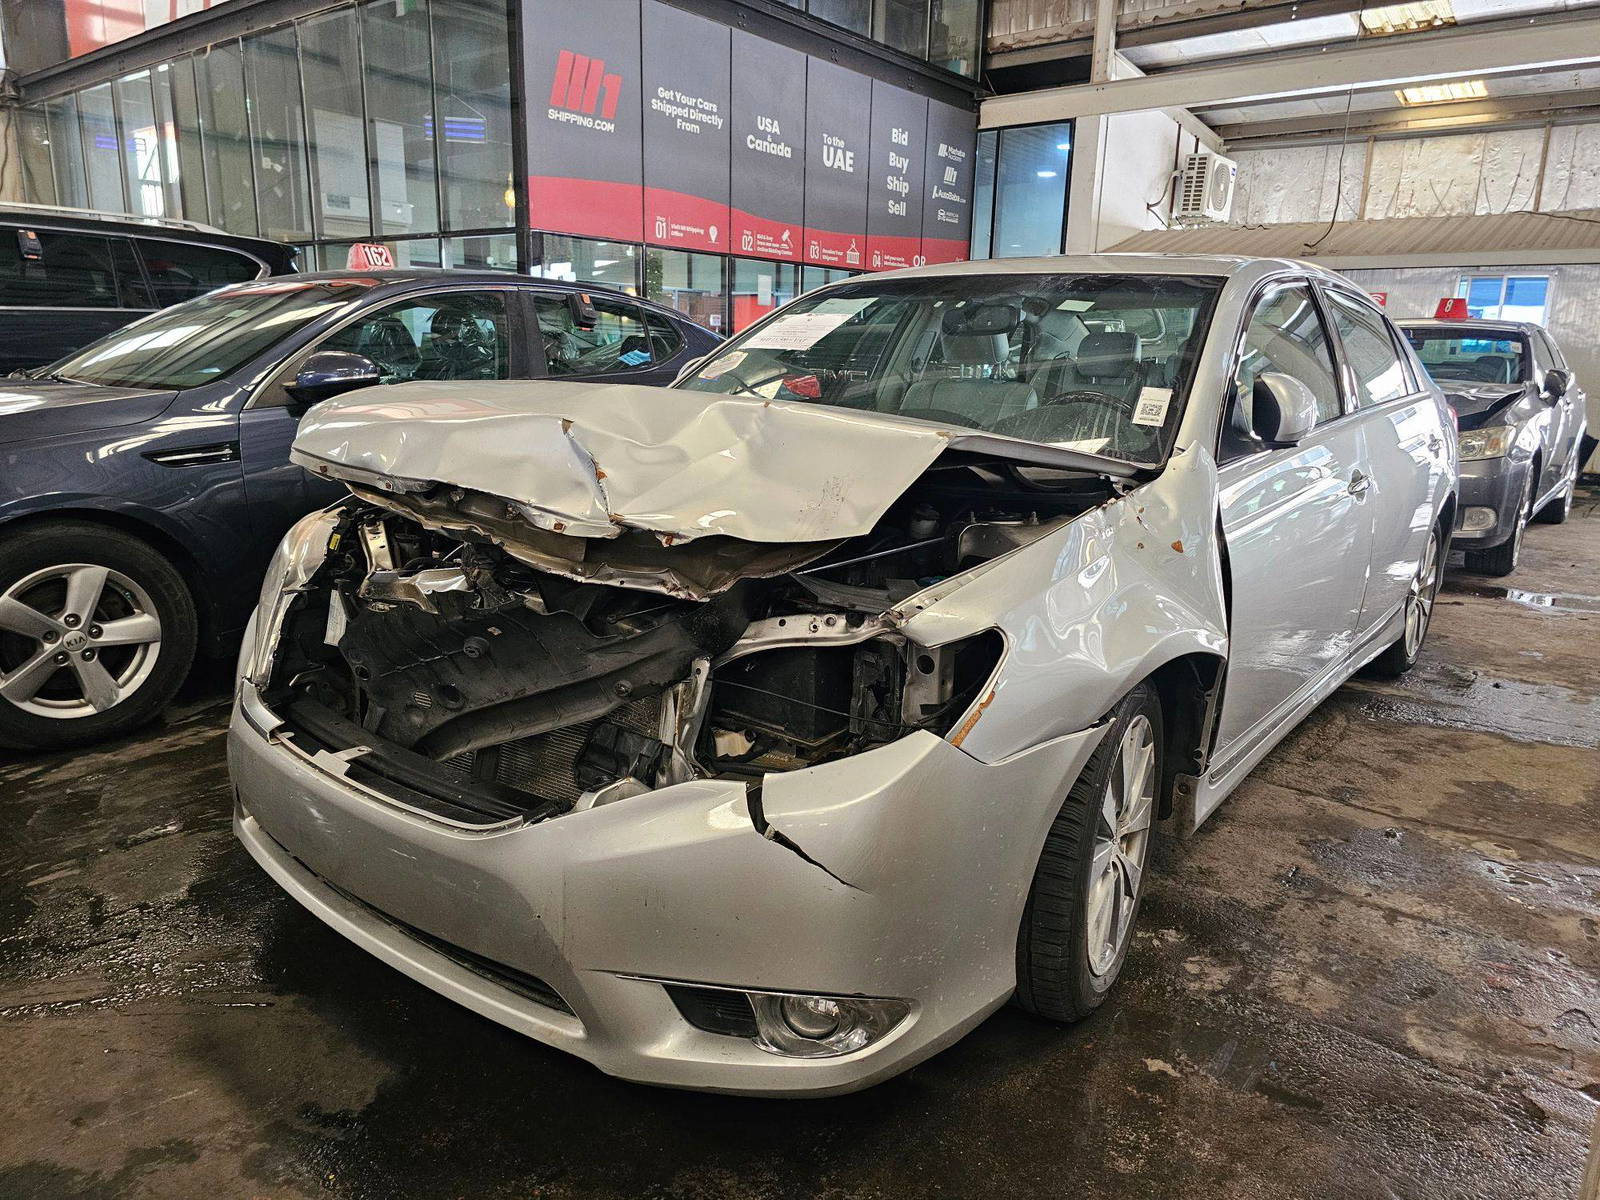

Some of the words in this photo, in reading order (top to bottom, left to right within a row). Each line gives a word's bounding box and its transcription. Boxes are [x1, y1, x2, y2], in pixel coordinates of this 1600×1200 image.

[658, 87, 674, 101] Get
[675, 91, 697, 106] Your
[697, 98, 718, 112] Cars
[548, 108, 615, 133] SHIPPING.COM
[651, 98, 689, 118] Shipped
[689, 108, 723, 130] Directly
[676, 118, 700, 134] From
[757, 115, 780, 135] USA
[746, 134, 792, 158] Canada
[822, 133, 833, 144] To
[833, 136, 845, 148] the
[891, 127, 908, 146] Bid
[822, 145, 854, 172] UAE
[888, 151, 909, 174] Buy
[886, 175, 909, 197] Ship
[888, 199, 906, 216] Sell
[655, 221, 666, 239] 01
[742, 235, 753, 251] 02
[810, 245, 820, 259] 03
[364, 246, 391, 266] 162
[872, 254, 881, 268] 04
[913, 255, 926, 267] OR
[66, 636, 85, 647] KIA
